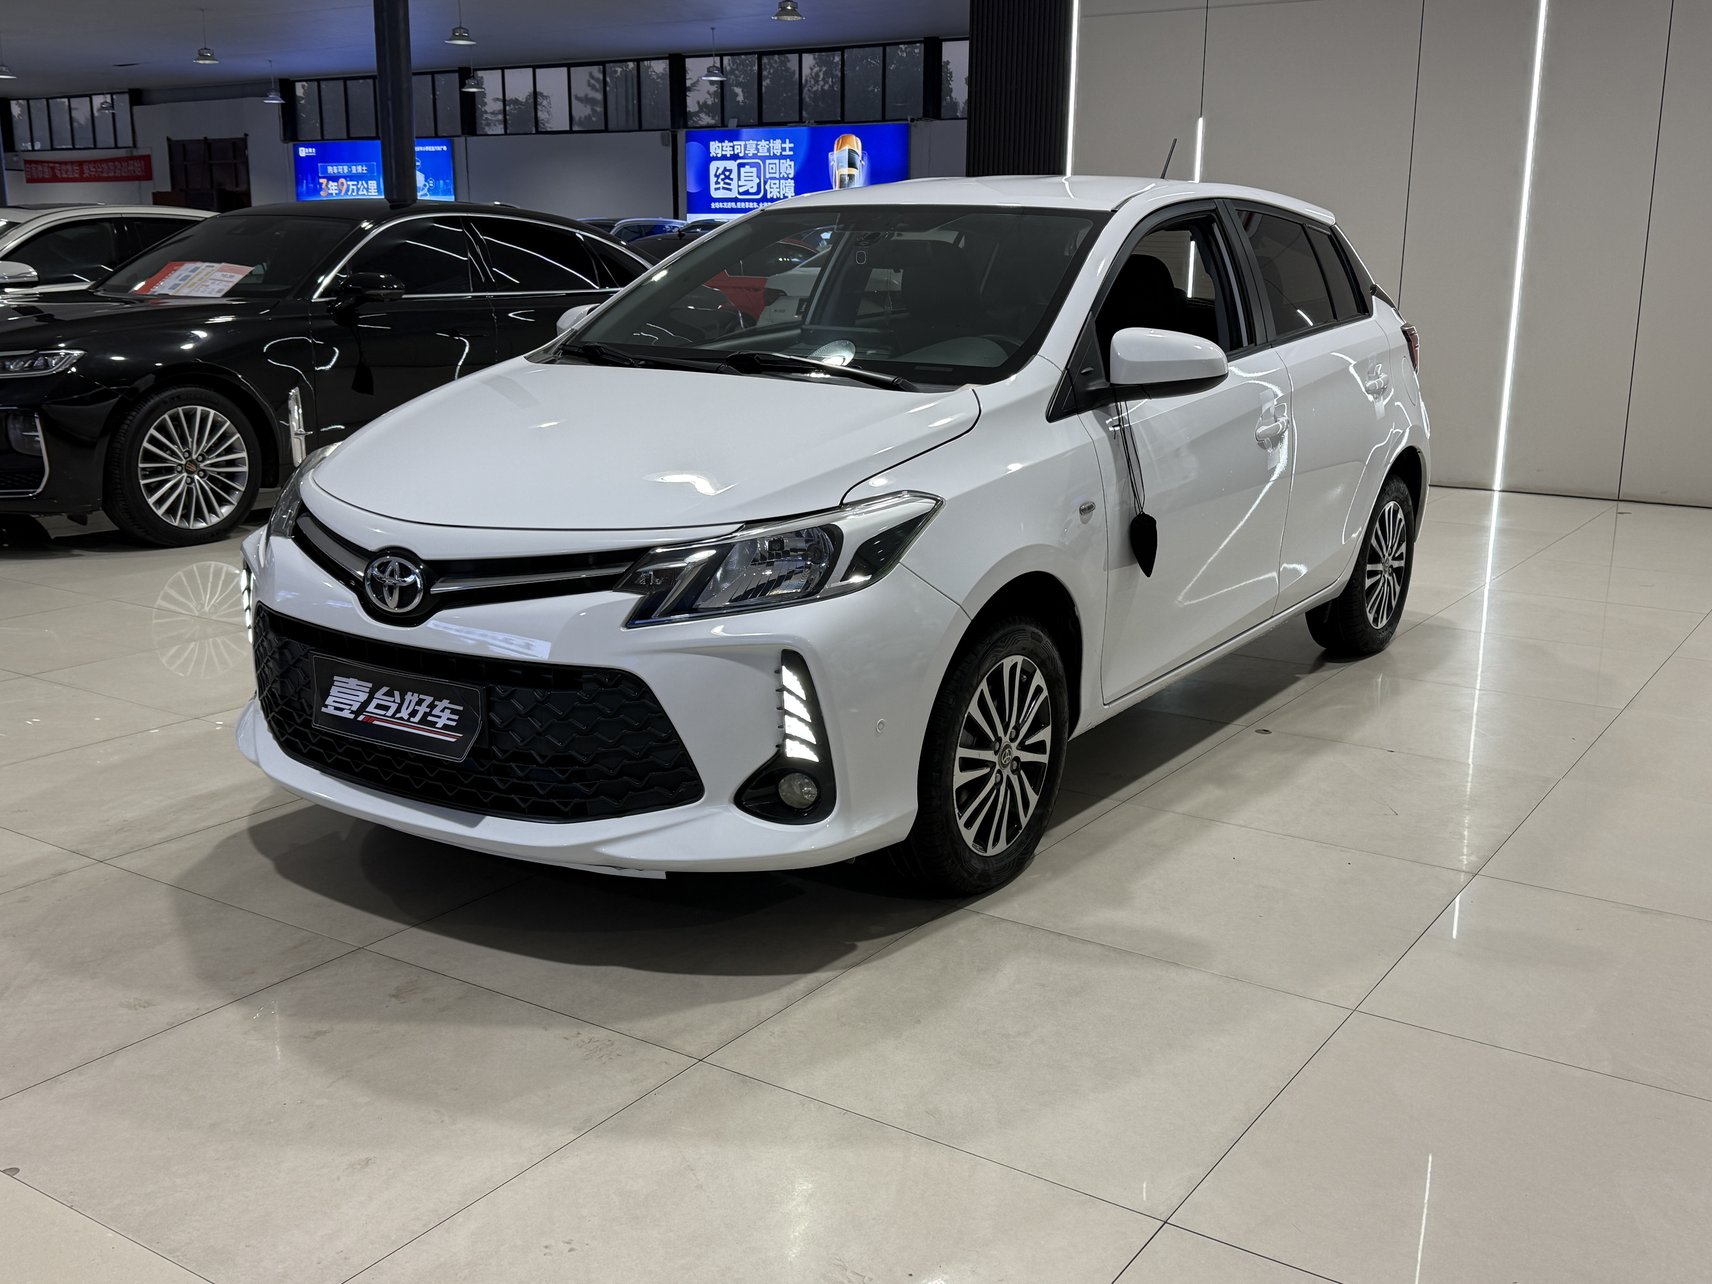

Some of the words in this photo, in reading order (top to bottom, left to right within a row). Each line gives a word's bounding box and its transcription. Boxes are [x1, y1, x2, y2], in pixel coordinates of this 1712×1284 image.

[709, 139, 794, 157] 购车可享查博士
[765, 159, 795, 178] 回购
[319, 178, 379, 197] 3年9万公里
[713, 165, 760, 193] 终身
[765, 179, 796, 198] 保障
[320, 675, 464, 728] 壹台好车
